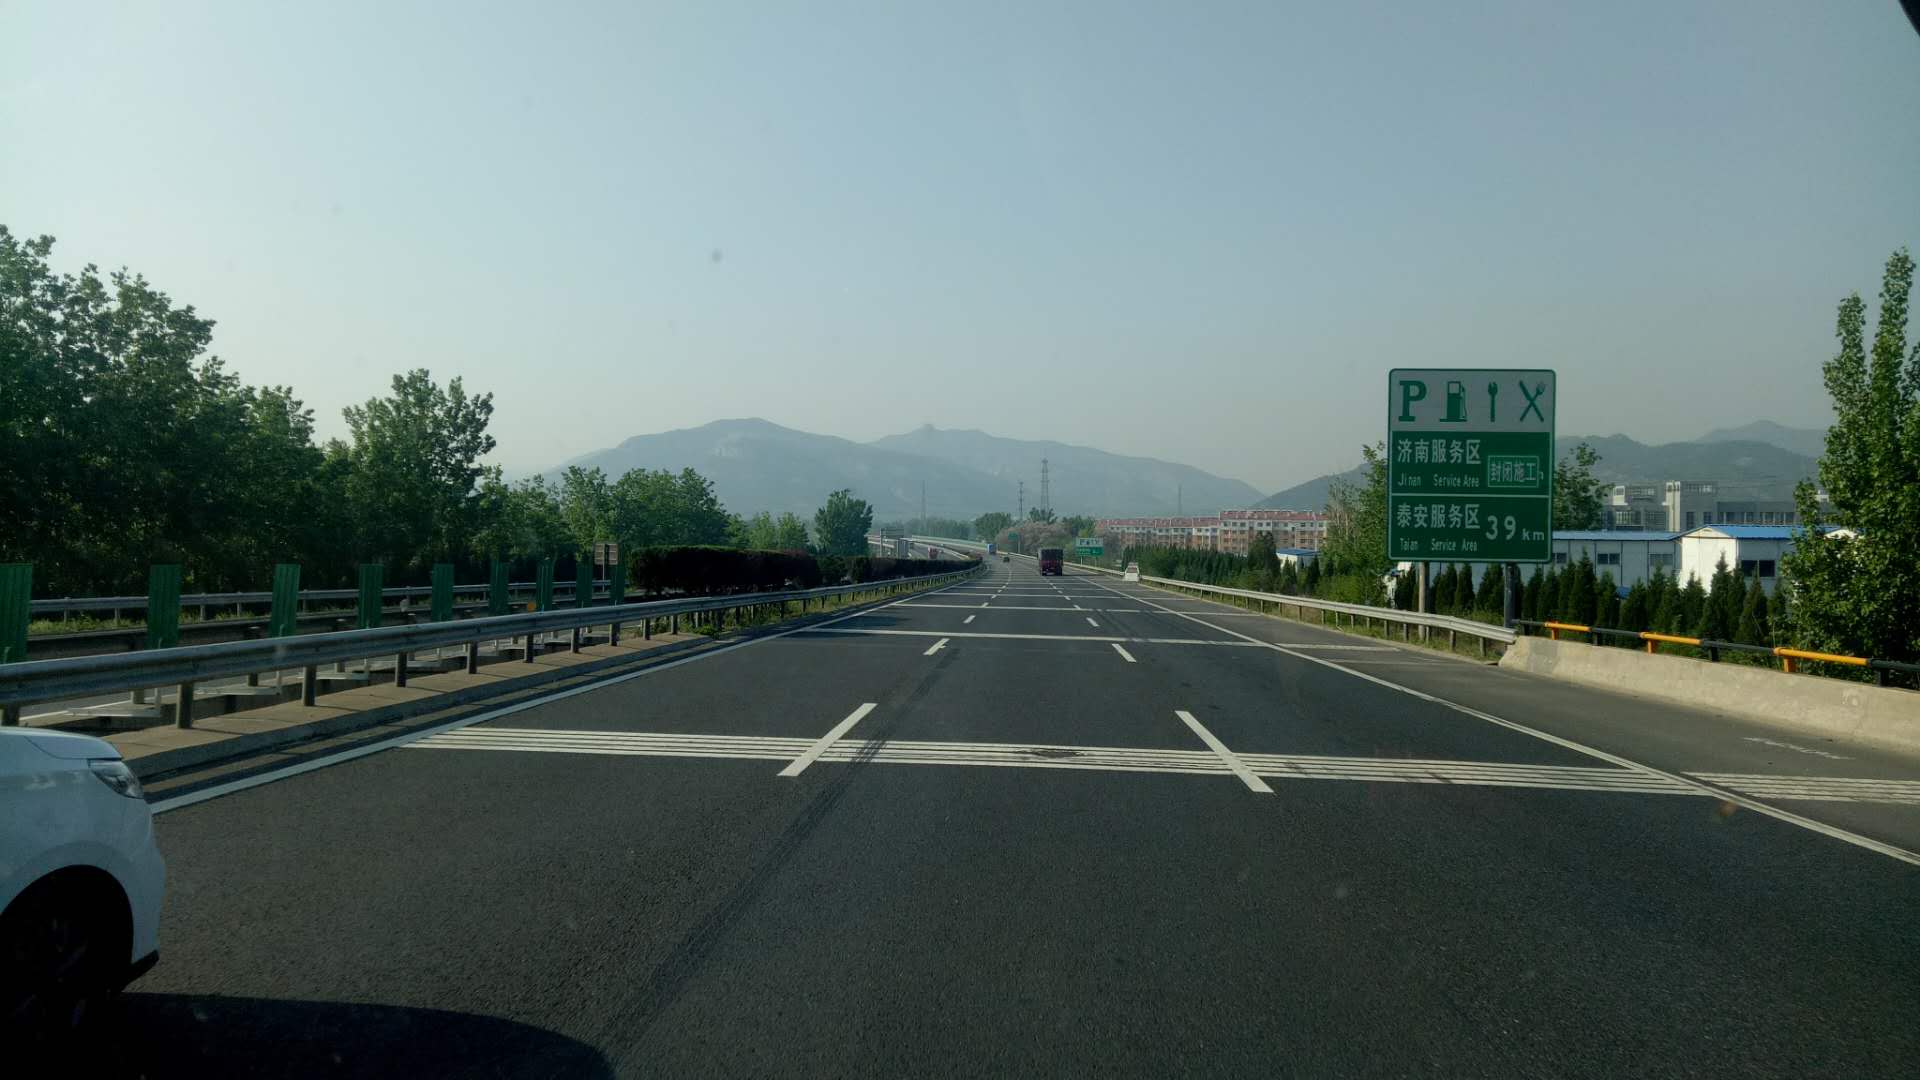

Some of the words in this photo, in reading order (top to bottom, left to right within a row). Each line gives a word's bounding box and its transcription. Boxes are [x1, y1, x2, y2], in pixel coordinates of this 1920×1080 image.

[1398, 380, 1427, 422] P
[1397, 438, 1482, 465] 济南服务区
[1433, 473, 1461, 487] Service
[1463, 474, 1480, 487] Area
[1490, 461, 1537, 483] 封闭施工
[1396, 502, 1481, 530] 泰安服务区
[1485, 515, 1516, 541] 39
[1522, 528, 1545, 541] km
[1431, 537, 1457, 551] Service
[1461, 538, 1478, 552] Area
